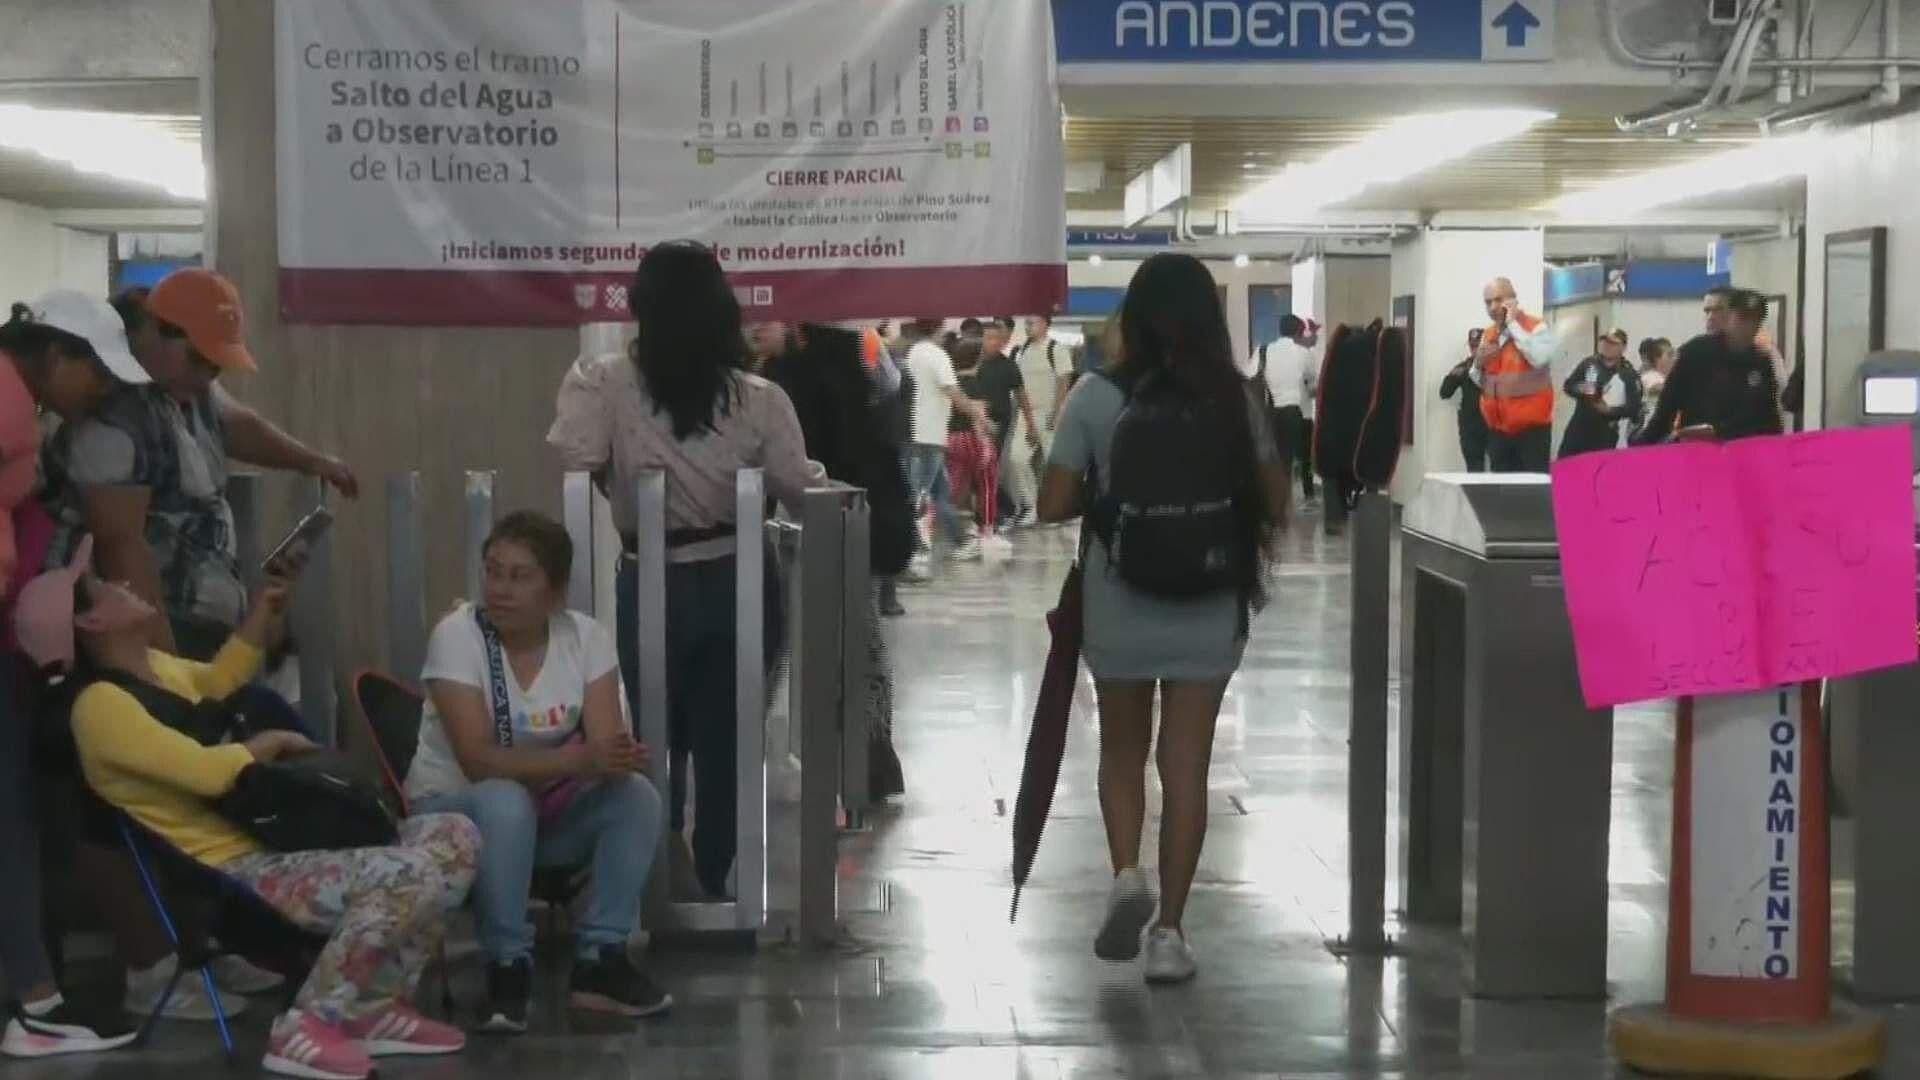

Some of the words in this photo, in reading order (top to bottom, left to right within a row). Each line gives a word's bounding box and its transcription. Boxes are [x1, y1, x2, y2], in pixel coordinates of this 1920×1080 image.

[1116, 1, 1415, 47] ANDENES
[303, 43, 448, 72] Cerramos
[455, 46, 480, 72] el
[490, 51, 581, 77] tramo
[919, 57, 929, 79] DEL
[331, 80, 408, 107] Salto
[419, 82, 467, 109] del
[475, 83, 554, 116] Agua
[919, 80, 929, 113] SALTO
[326, 122, 343, 144] a
[352, 117, 558, 147] Observatorio
[350, 155, 387, 182] de
[397, 155, 421, 182] la
[431, 155, 510, 184] Línea
[521, 158, 533, 183] 1
[765, 170, 829, 187] CIERRE
[834, 167, 907, 185] PARCIAL
[442, 240, 555, 264] ¡Iniciamos
[737, 237, 906, 262] modernización!
